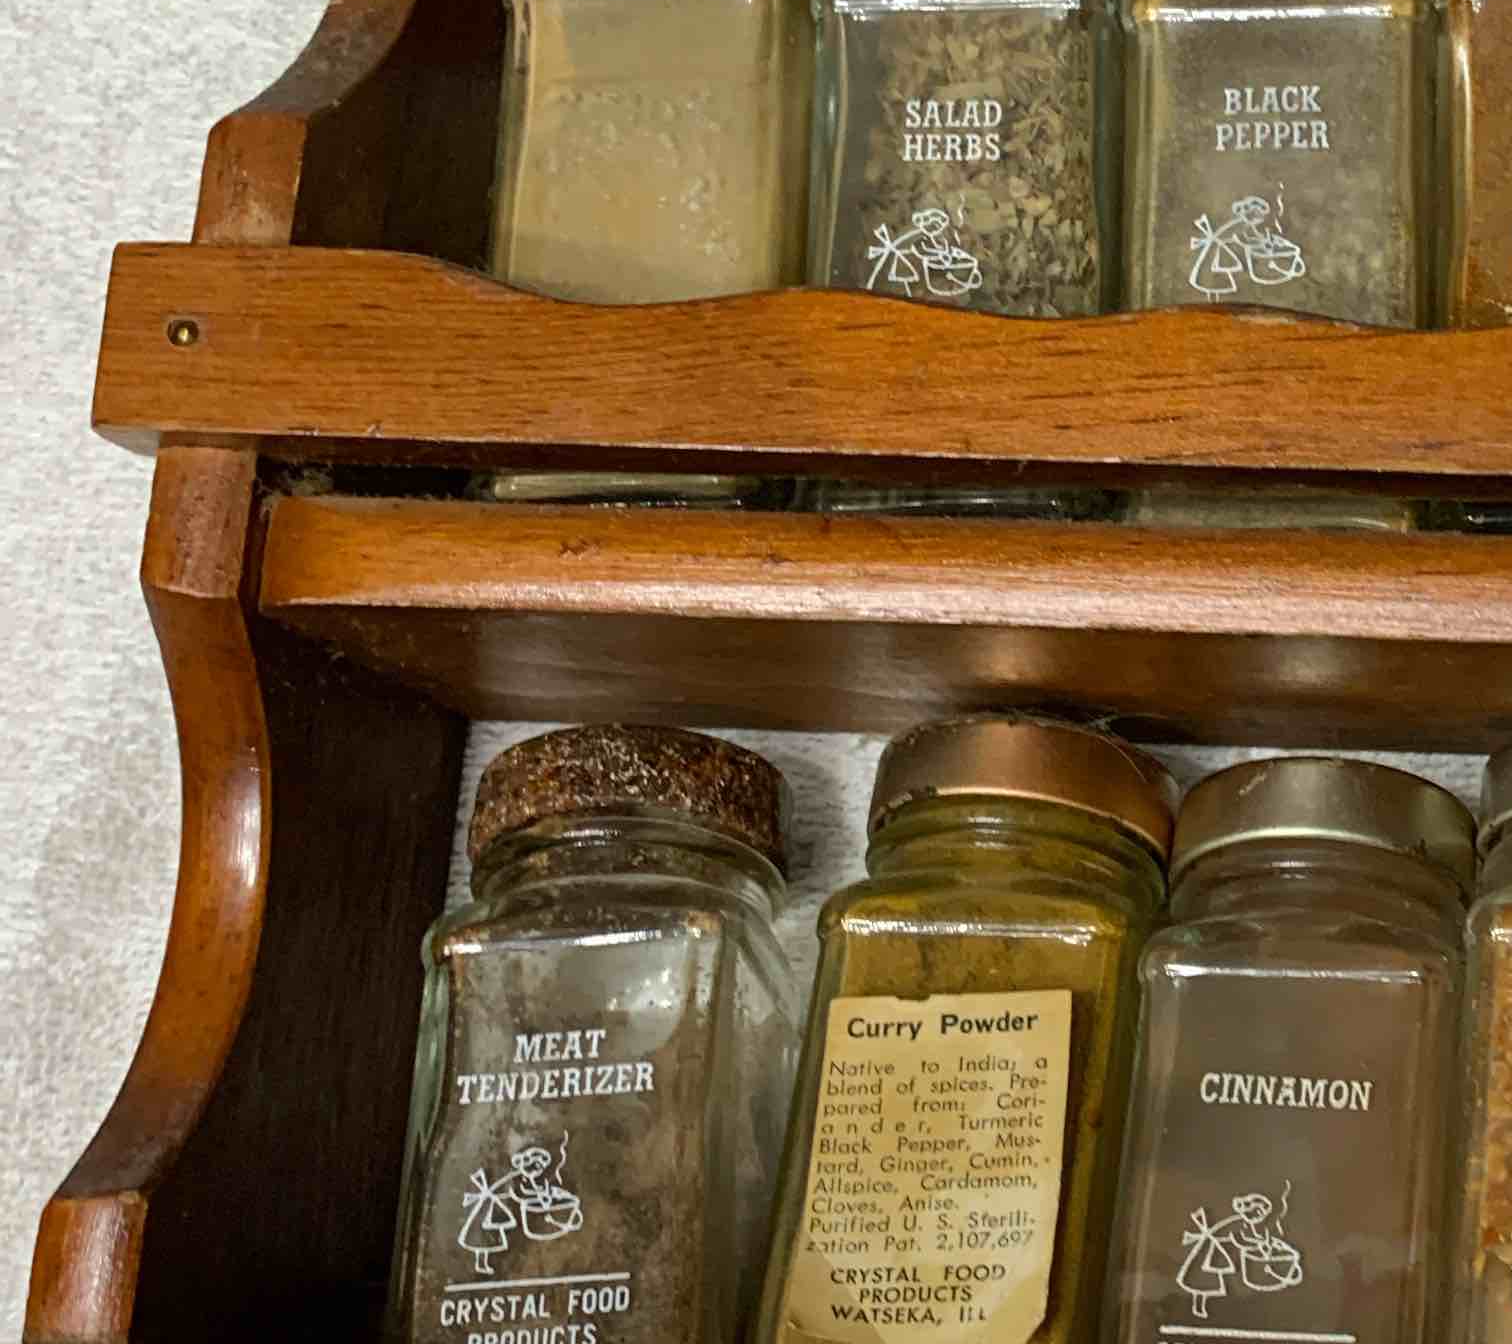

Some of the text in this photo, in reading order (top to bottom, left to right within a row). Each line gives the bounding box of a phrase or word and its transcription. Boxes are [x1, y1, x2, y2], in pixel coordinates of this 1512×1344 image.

[1223, 85, 1322, 116] BLACK
[905, 98, 1003, 128] SALAD
[902, 133, 1001, 162] HERBS
[1215, 119, 1330, 152] PEPPER
[847, 1010, 1040, 1040] Curry Powder
[513, 1028, 607, 1064] MEAT
[829, 1060, 895, 1077] Native
[921, 1060, 940, 1074] to
[1035, 1057, 1048, 1070] a
[456, 1062, 656, 1104] TENDERIZER
[827, 1077, 883, 1096] blend
[896, 1075, 915, 1095] of
[1010, 1072, 1048, 1089] Pre-
[1199, 1072, 1374, 1112] CINNAMON
[823, 1096, 882, 1116] pared
[996, 1092, 1046, 1110] Cori-
[958, 1112, 1043, 1130] Turmeric
[819, 1136, 872, 1154] Black
[995, 1133, 1041, 1149] Mus-
[810, 1215, 891, 1234] Purified
[806, 1238, 870, 1254] zation
[830, 1263, 1006, 1285] CRYSTAL FOOD
[440, 1285, 630, 1327] CRYSTAL FOOD
[859, 1285, 973, 1304] PRODUCTS
[831, 1304, 943, 1326] WATSEKA,
